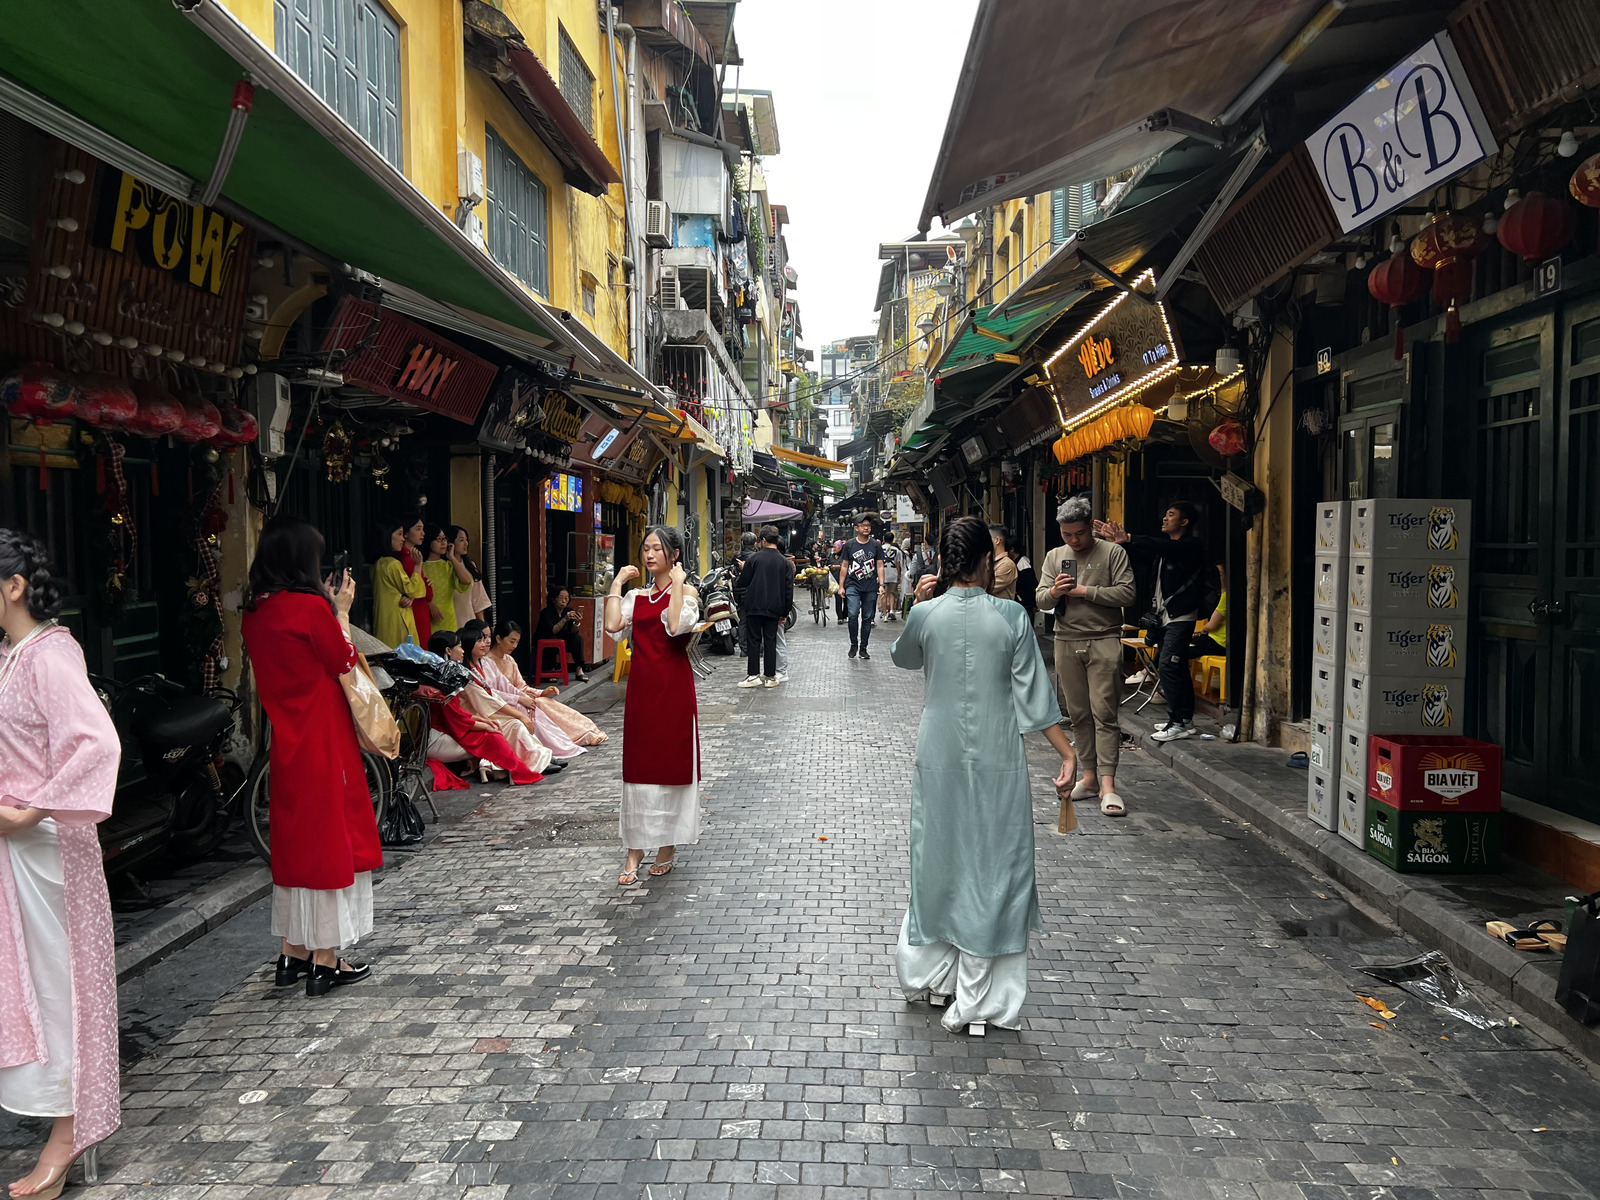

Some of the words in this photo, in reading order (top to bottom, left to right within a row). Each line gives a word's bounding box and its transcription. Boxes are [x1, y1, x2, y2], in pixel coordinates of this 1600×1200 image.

[1324, 63, 1462, 218] B&B
[110, 171, 244, 296] POW
[1539, 264, 1556, 292] 19
[1078, 336, 1114, 378] Olive
[1388, 513, 1426, 531] Tiger
[1388, 571, 1425, 589] Tiger
[1386, 630, 1425, 648] Tiger
[1383, 689, 1420, 707] Tiger
[1428, 773, 1448, 786] BIA
[1449, 771, 1475, 788] VIỆT
[1370, 827, 1393, 849] SAIGON
[1472, 820, 1480, 864] SPECIAL
[1407, 853, 1450, 863] SAIGON
